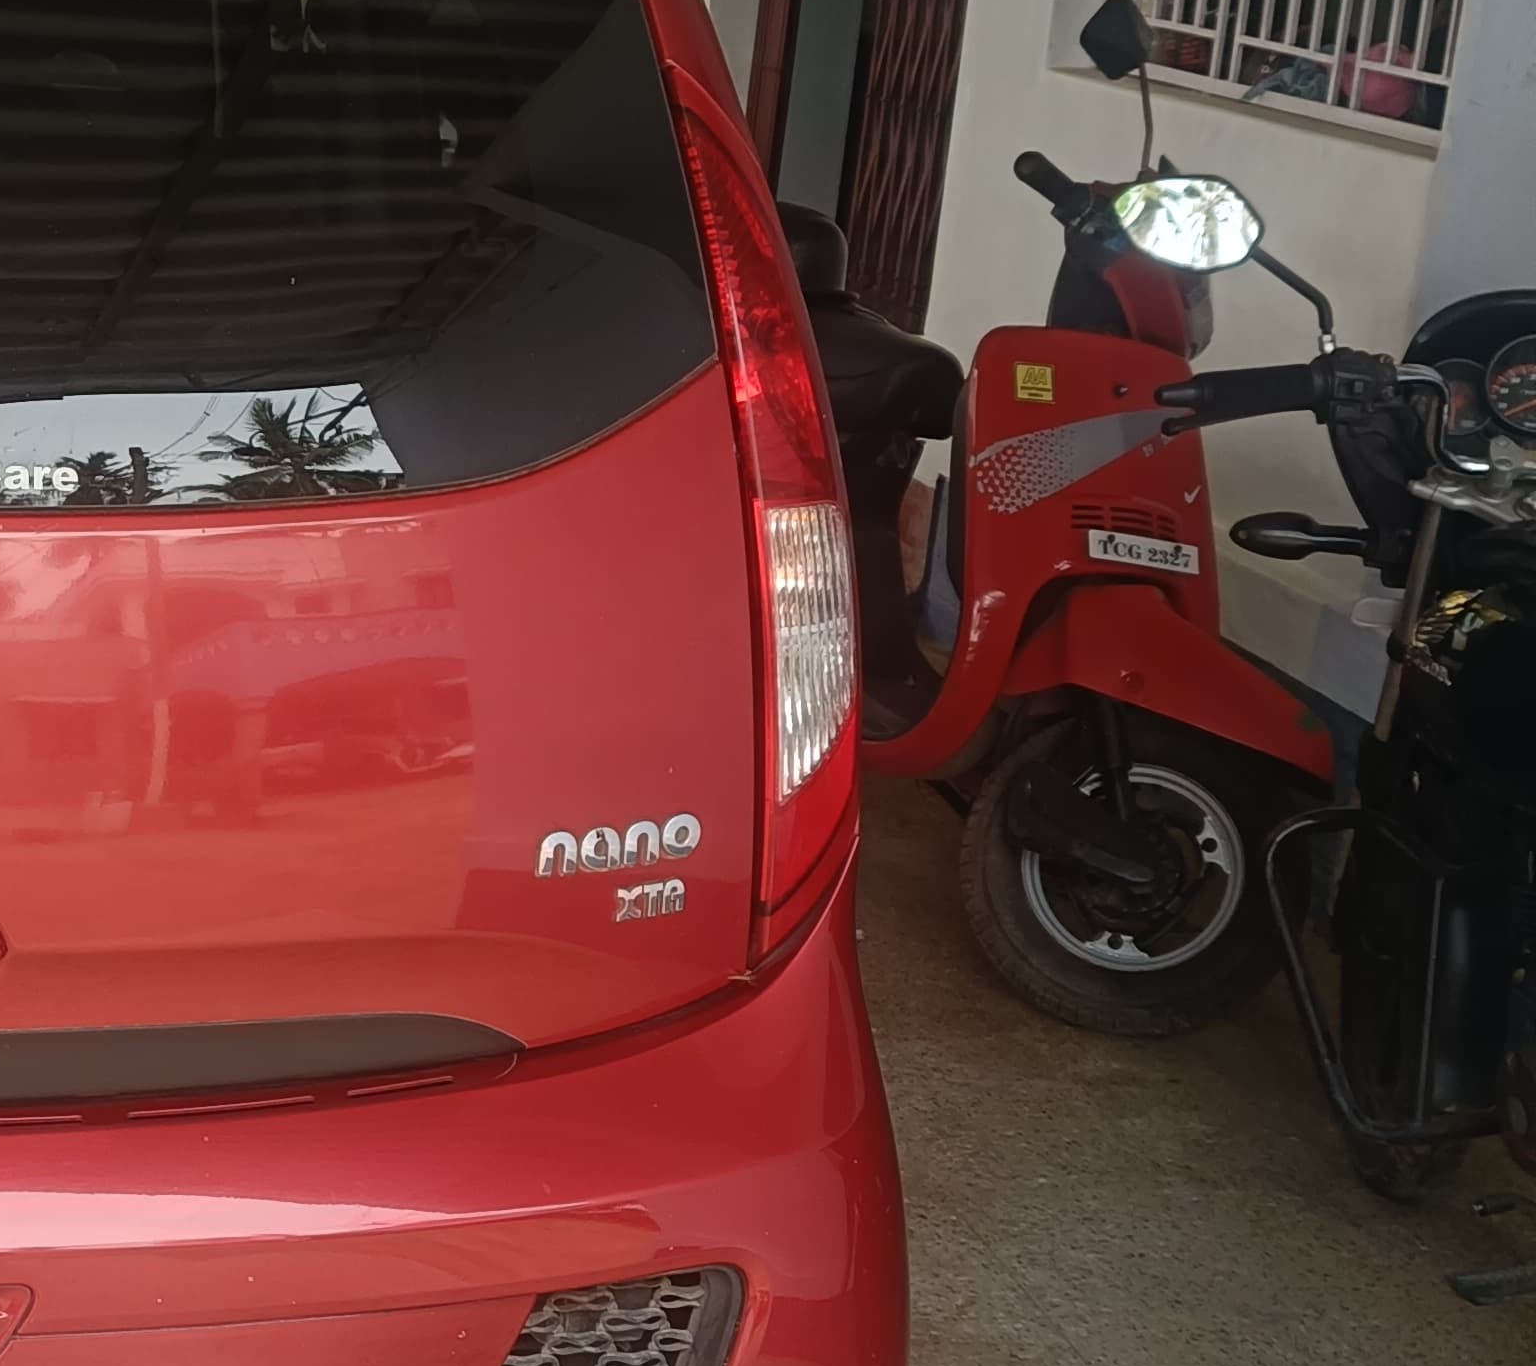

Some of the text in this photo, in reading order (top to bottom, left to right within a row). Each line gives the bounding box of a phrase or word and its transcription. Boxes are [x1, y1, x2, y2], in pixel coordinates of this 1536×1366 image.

[1098, 540, 1192, 568] TCG 2327
[535, 812, 702, 877] nano
[614, 878, 686, 923] XTA
